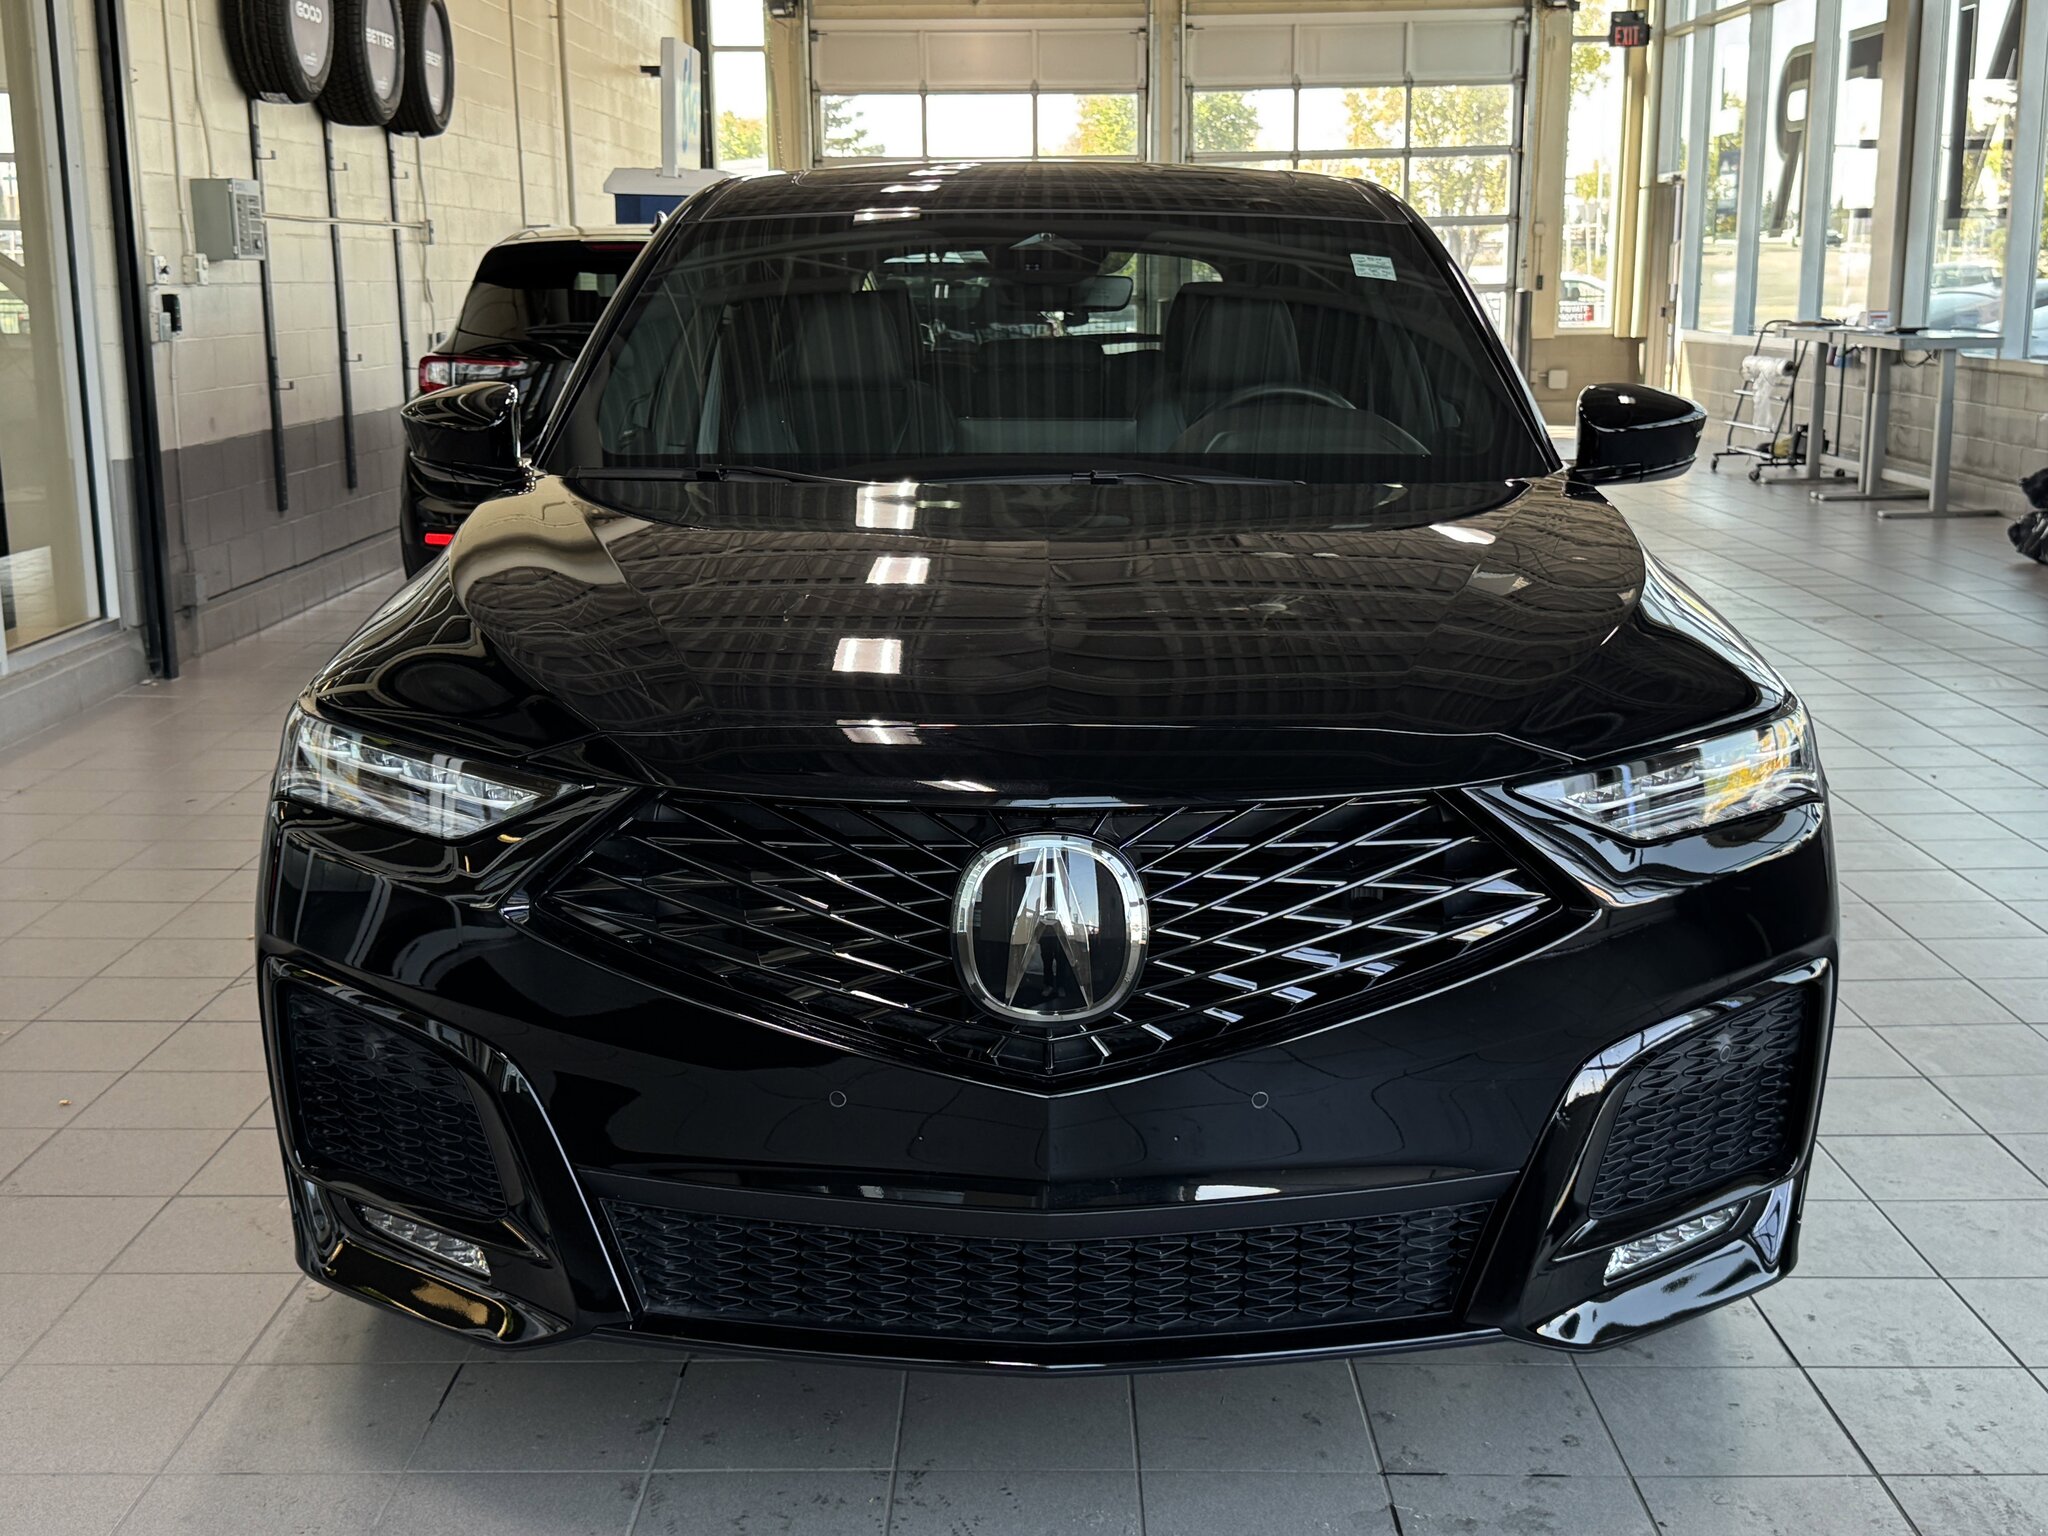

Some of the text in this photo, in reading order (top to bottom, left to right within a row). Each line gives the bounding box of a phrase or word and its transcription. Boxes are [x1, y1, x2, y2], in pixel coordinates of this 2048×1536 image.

[295, 1, 322, 23] GOOD
[366, 27, 395, 50] BETTER
[1614, 25, 1640, 46] EXIT
